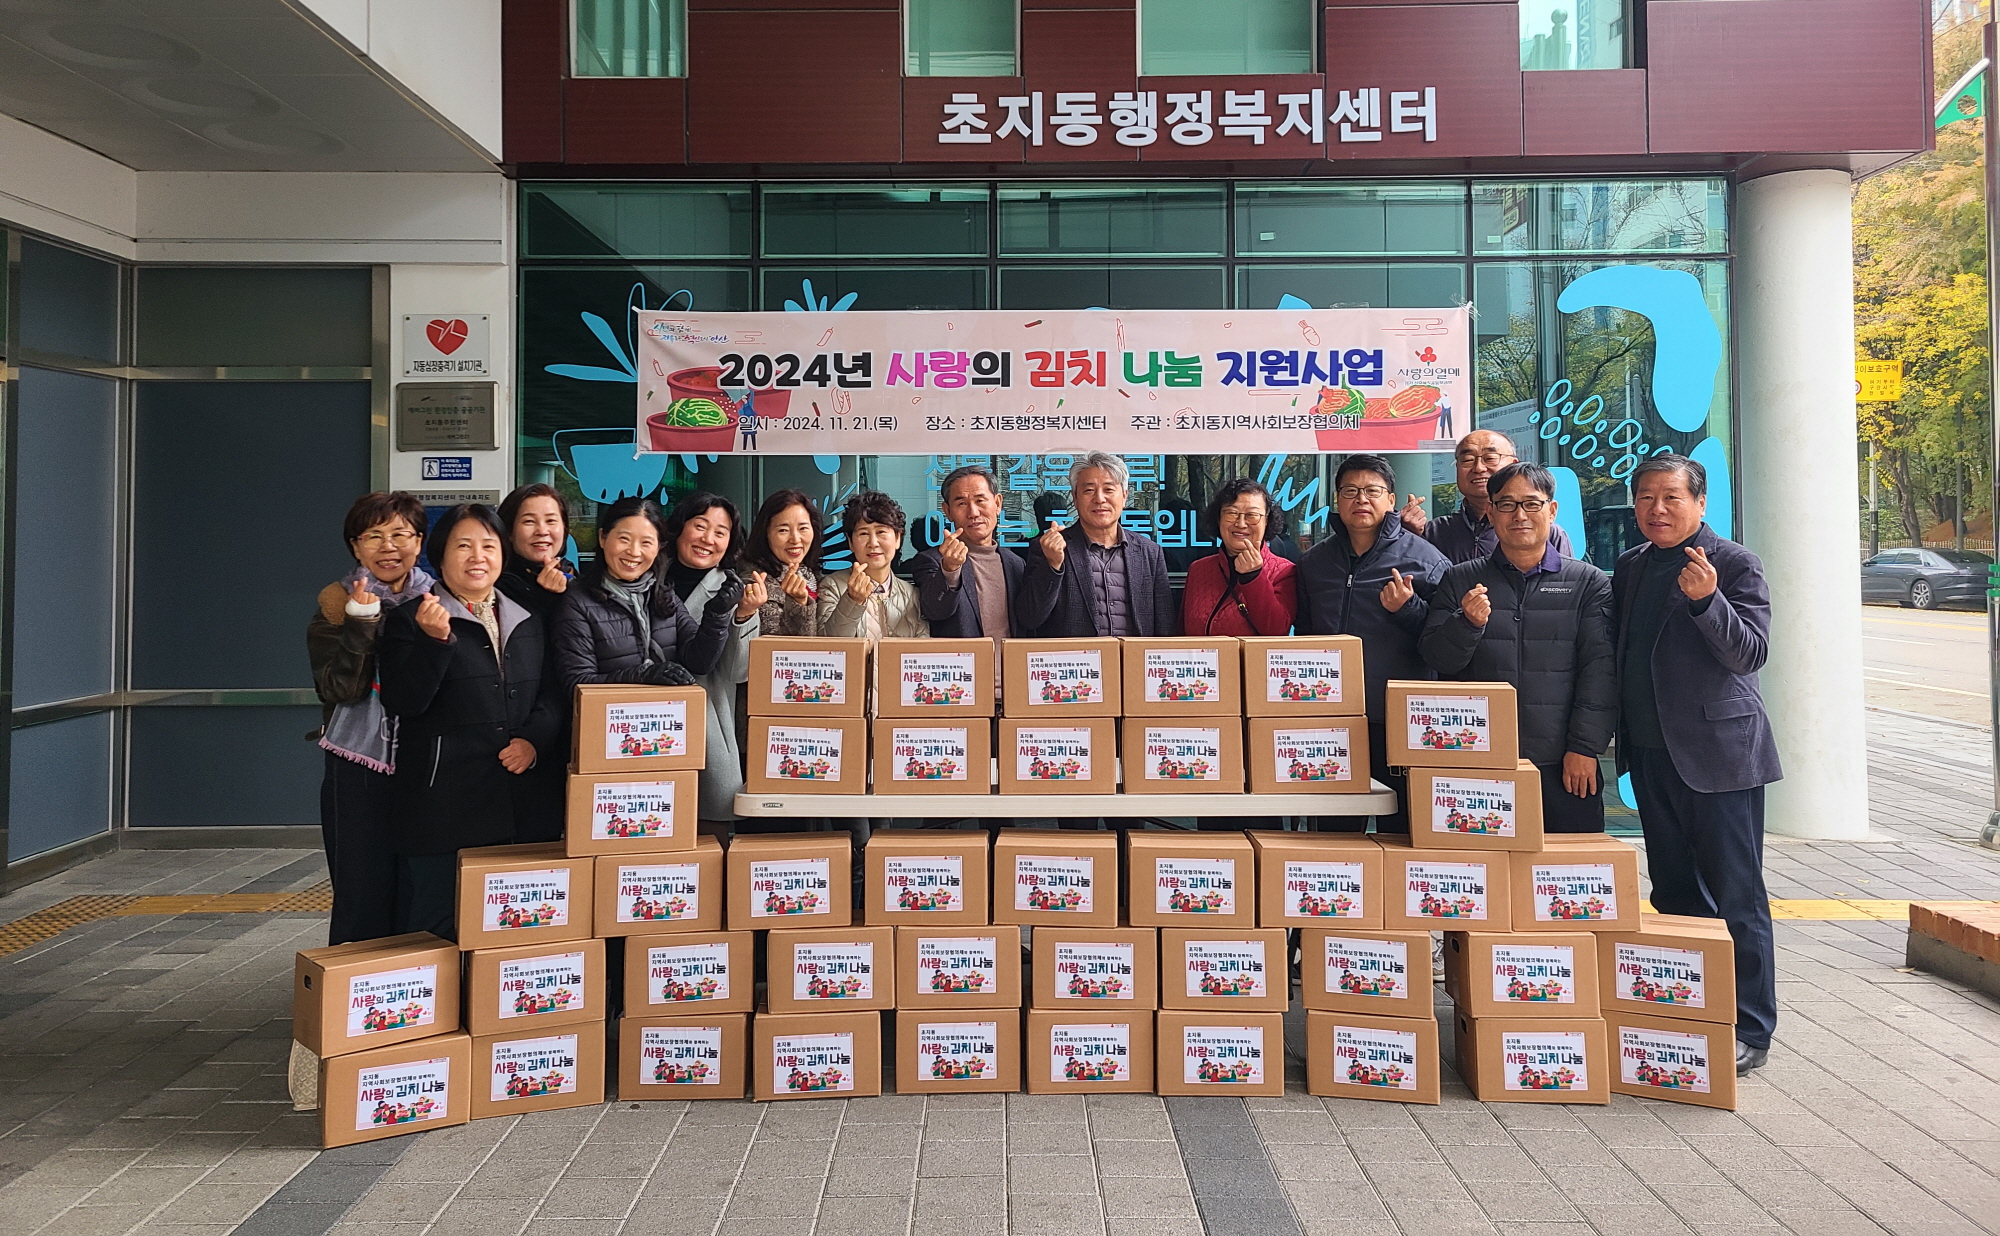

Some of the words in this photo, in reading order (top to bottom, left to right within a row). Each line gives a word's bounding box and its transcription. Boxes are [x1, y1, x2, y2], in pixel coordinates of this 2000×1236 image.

[938, 86, 1437, 147] 초지동행정복지센터
[412, 360, 456, 373] 자동심장충격기
[457, 360, 483, 373] 설치기관
[719, 351, 872, 388] 2024년
[885, 351, 1012, 388] 사랑의
[1025, 350, 1107, 388] 김치
[1123, 350, 1203, 388] 나눔
[1216, 348, 1383, 388] 지원사업
[1397, 367, 1460, 380] 사랑의열매
[738, 416, 769, 431] 일시
[783, 417, 825, 431] 2024.
[830, 417, 848, 431] 11.
[853, 416, 899, 432] 21.(목)
[925, 416, 956, 431] 장소
[970, 415, 1107, 431] 초지동행정복지센터
[1131, 414, 1162, 431] 주관
[1175, 413, 1361, 431] 초지동지역사회보장협의체
[774, 669, 800, 679] 사랑의
[802, 669, 821, 679] 김치
[823, 669, 843, 679] 나눔
[1030, 669, 1057, 681] 사랑의
[1058, 668, 1077, 680] 김치
[1079, 667, 1099, 679] 나눔
[1269, 667, 1296, 678] 사랑의
[1298, 667, 1317, 678] 김치
[1319, 667, 1339, 678] 나눔
[609, 721, 637, 734] 사랑의
[639, 720, 660, 732] 김치
[663, 719, 683, 731] 나눔
[1410, 714, 1439, 725] 사랑의
[1440, 715, 1462, 726] 김치
[1464, 715, 1486, 726] 나눔
[895, 745, 921, 756] 사랑의
[923, 745, 942, 756] 김치
[945, 745, 964, 756] 나눔
[1147, 745, 1174, 755] 사랑의
[1176, 745, 1195, 756] 김치
[1197, 745, 1217, 756] 나눔
[596, 802, 625, 814] 사랑의
[626, 801, 647, 813] 김치
[650, 800, 671, 812] 나눔
[1435, 795, 1464, 808] 사랑의
[1466, 797, 1487, 809] 김치
[1490, 799, 1512, 811] 나눔
[753, 879, 781, 891] 사랑의
[783, 878, 803, 890] 김치
[806, 876, 827, 889] 나눔
[887, 875, 915, 886] 사랑의
[917, 875, 937, 886] 김치
[939, 874, 960, 886] 나눔
[1158, 877, 1186, 888] 사랑의
[1188, 877, 1208, 888] 김치
[1211, 877, 1232, 888] 나눔
[1408, 880, 1437, 892] 사랑의
[1439, 881, 1460, 893] 김치
[1462, 882, 1484, 894] 나눔
[621, 884, 650, 896] 사랑의
[651, 883, 672, 895] 김치
[675, 882, 696, 894] 나눔
[1536, 883, 1565, 895] 사랑의
[1566, 883, 1588, 895] 김치
[1590, 882, 1613, 894] 나눔
[487, 891, 517, 905] 사랑의
[519, 889, 541, 903] 김치
[544, 887, 566, 901] 나눔
[651, 965, 680, 979] 사랑의
[682, 963, 702, 976] 김치
[705, 962, 726, 975] 나눔
[797, 962, 825, 974] 사랑의
[826, 962, 847, 974] 김치
[849, 961, 870, 973] 나눔
[1188, 960, 1217, 971] 사랑의
[1218, 960, 1239, 971] 김치
[1241, 960, 1262, 971] 나눔
[1328, 956, 1357, 969] 사랑의
[1358, 958, 1380, 971] 김치
[1382, 960, 1404, 973] 나눔
[1495, 964, 1524, 976] 사랑의
[1526, 965, 1547, 976] 김치
[1549, 965, 1571, 977] 나눔
[1618, 962, 1650, 976] 사랑의
[1651, 966, 1674, 979] 김치
[1677, 968, 1701, 982] 나눔
[502, 977, 533, 992] 사랑의
[535, 974, 556, 989] 김치
[559, 971, 581, 985] 나눔
[351, 992, 384, 1009] 사랑의
[385, 988, 408, 1004] 김치
[410, 984, 433, 1000] 나눔
[643, 1046, 672, 1058] 사랑의
[674, 1046, 694, 1058] 김치
[697, 1046, 718, 1058] 나눔
[1053, 1044, 1081, 1056] 사랑의
[1083, 1044, 1103, 1056] 김치
[1106, 1043, 1126, 1055] 나눔
[1186, 1046, 1215, 1057] 사랑의
[1216, 1046, 1237, 1057] 김치
[1240, 1046, 1260, 1057] 나눔
[1336, 1045, 1365, 1059] 사랑의
[1367, 1048, 1389, 1061] 김치
[1391, 1050, 1413, 1063] 나눔
[1623, 1046, 1654, 1061] 사랑의
[1656, 1050, 1679, 1064] 김치
[1682, 1053, 1706, 1067] 나눔
[494, 1059, 525, 1075] 사랑의
[527, 1057, 549, 1071] 김치
[552, 1054, 574, 1068] 나눔
[776, 1054, 804, 1067] 사랑의
[806, 1053, 827, 1066] 김치
[829, 1052, 850, 1065] 나눔
[1506, 1052, 1535, 1064] 사랑의
[1537, 1052, 1559, 1064] 김치
[1561, 1052, 1583, 1064] 나눔
[360, 1085, 393, 1102] 사랑의
[395, 1082, 419, 1098] 김치
[421, 1078, 445, 1094] 나눔
